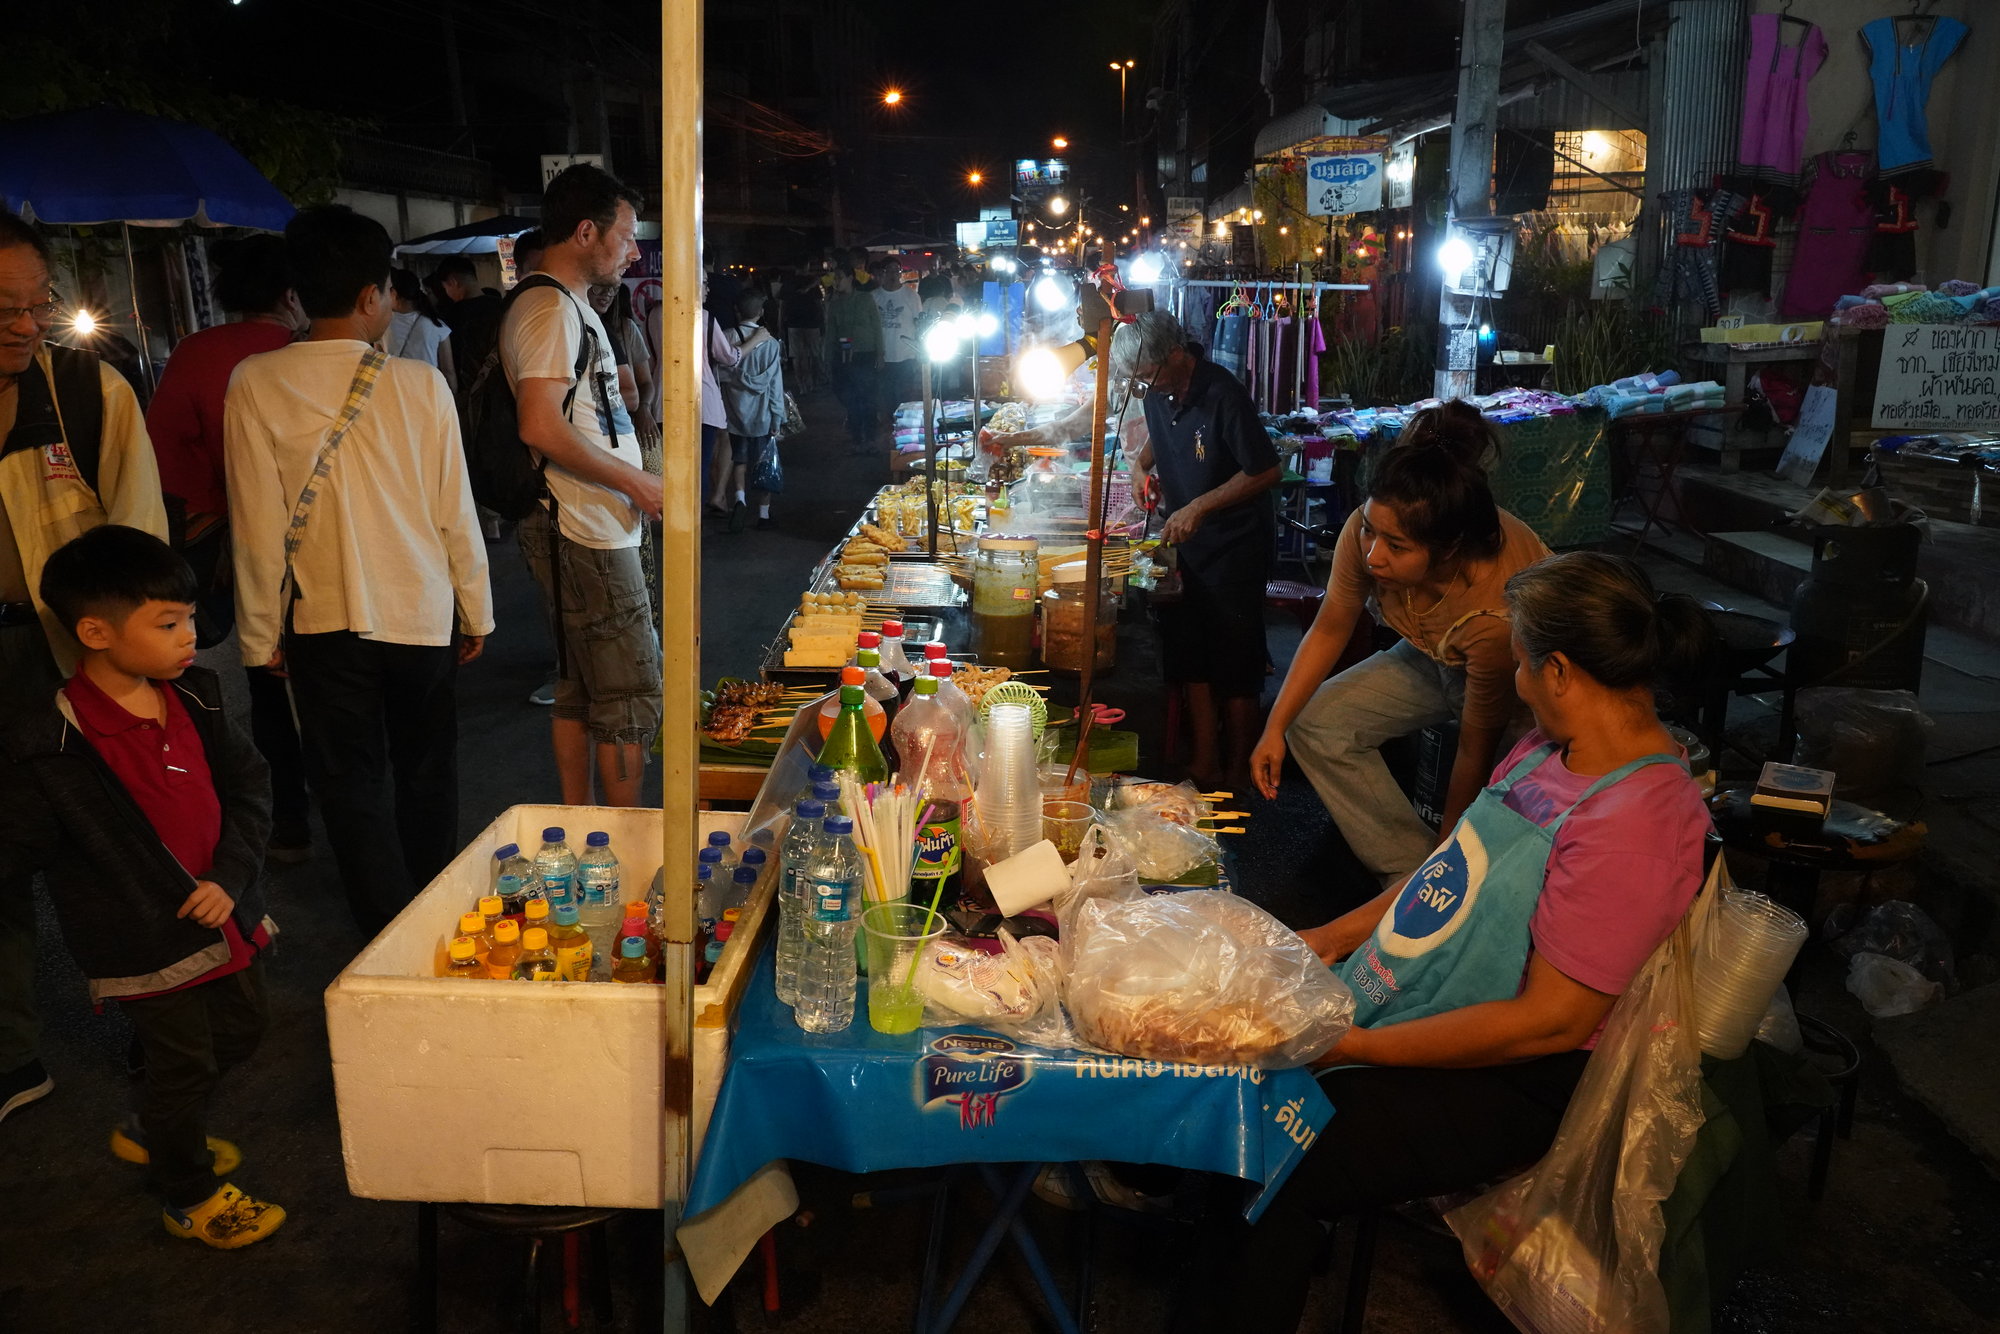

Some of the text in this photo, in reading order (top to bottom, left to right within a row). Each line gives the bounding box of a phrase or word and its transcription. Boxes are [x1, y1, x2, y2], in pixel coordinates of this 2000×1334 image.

[1315, 161, 1368, 179] นมสด
[934, 1062, 1015, 1086] Pure Life
